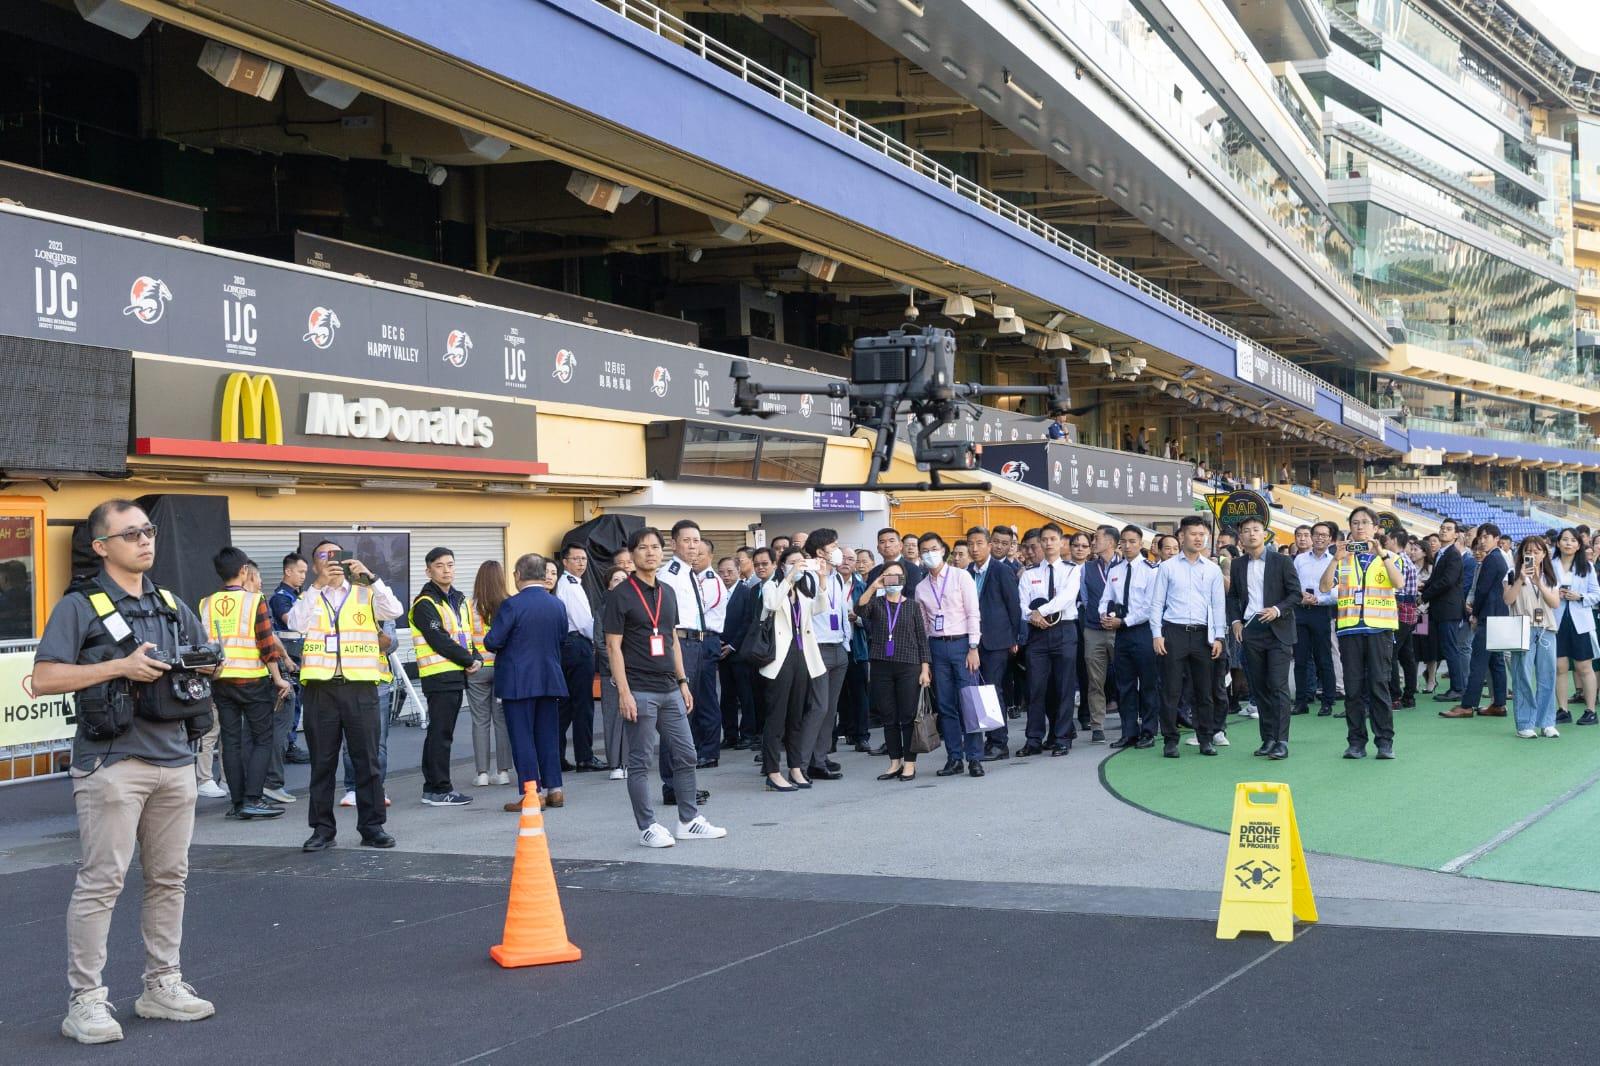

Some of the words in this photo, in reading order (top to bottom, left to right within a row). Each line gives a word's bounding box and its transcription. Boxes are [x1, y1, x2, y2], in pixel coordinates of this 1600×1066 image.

[48, 240, 63, 251] 2023
[34, 249, 77, 265] LONGINES
[35, 267, 78, 319] IJC
[223, 300, 257, 345] IJC
[382, 324, 397, 341] DEC
[400, 327, 405, 342] 6
[367, 341, 392, 359] HAPPY
[393, 345, 419, 363] VALLEY
[504, 346, 526, 382] IJC
[694, 378, 709, 408] IJC
[305, 391, 494, 449] McDonald's
[1227, 501, 1258, 515] BAR
[1240, 825, 1280, 834] DRONE
[1240, 834, 1280, 843] FLIGHT
